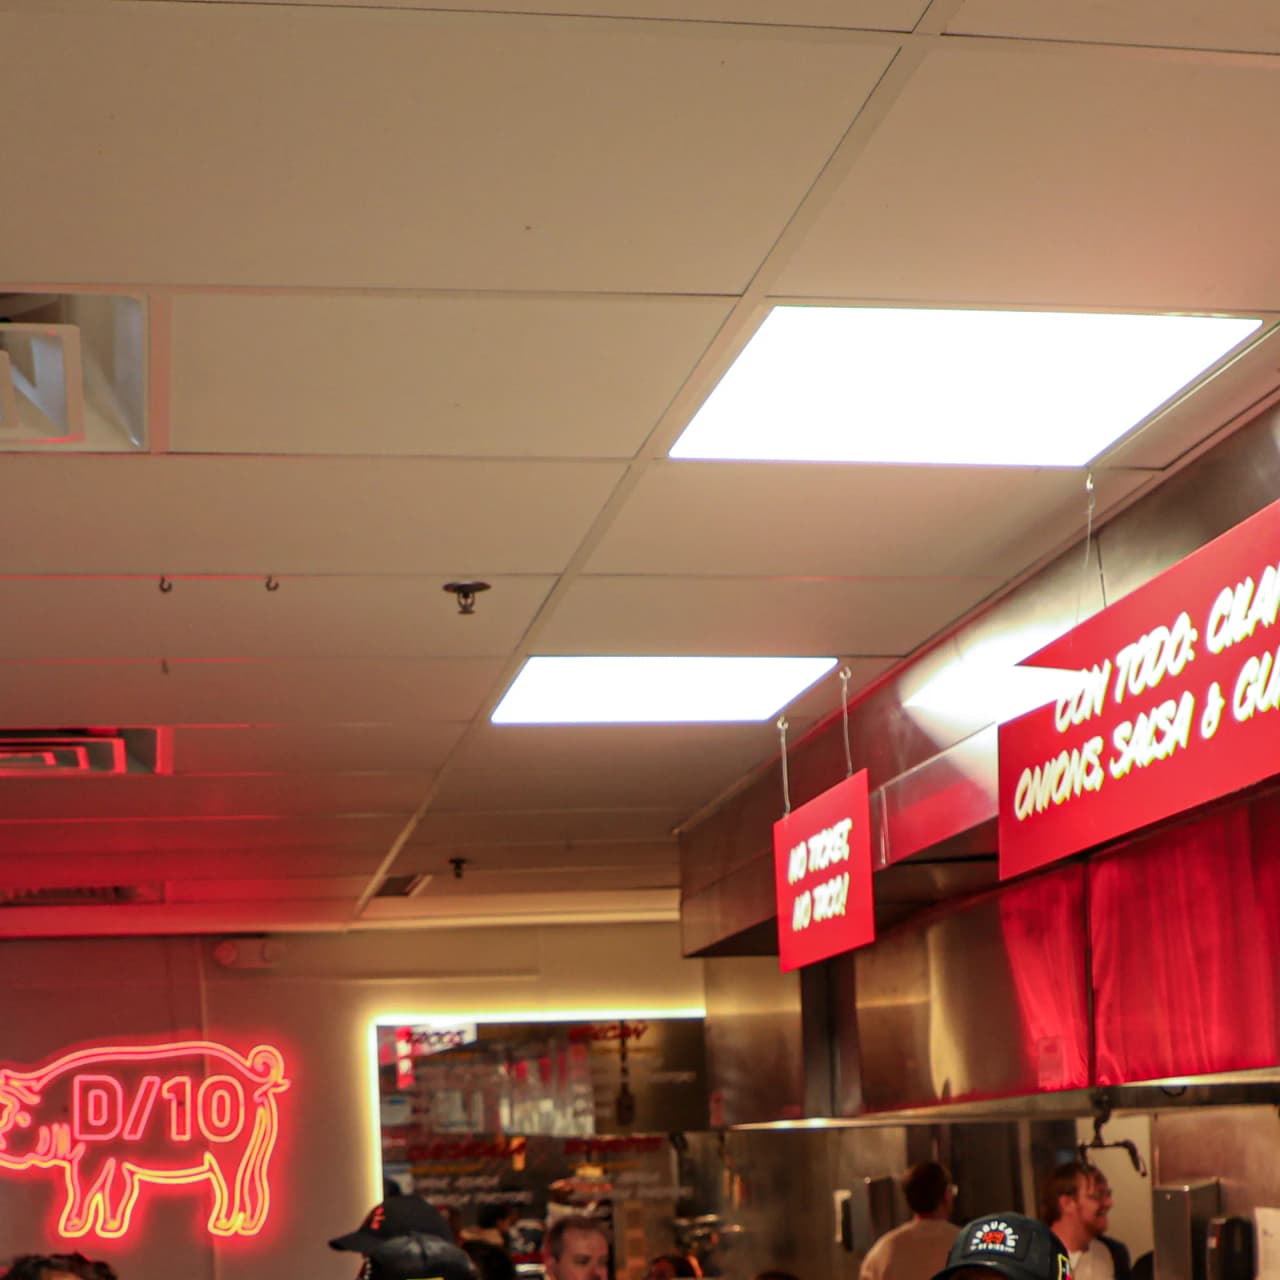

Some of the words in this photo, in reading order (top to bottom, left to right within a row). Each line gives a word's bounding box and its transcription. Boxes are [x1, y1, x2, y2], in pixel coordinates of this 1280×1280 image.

[1115, 611, 1199, 703] TODO:
[1109, 690, 1195, 780] SALSA
[1200, 681, 1225, 739] &
[73, 1074, 245, 1142] D/10
